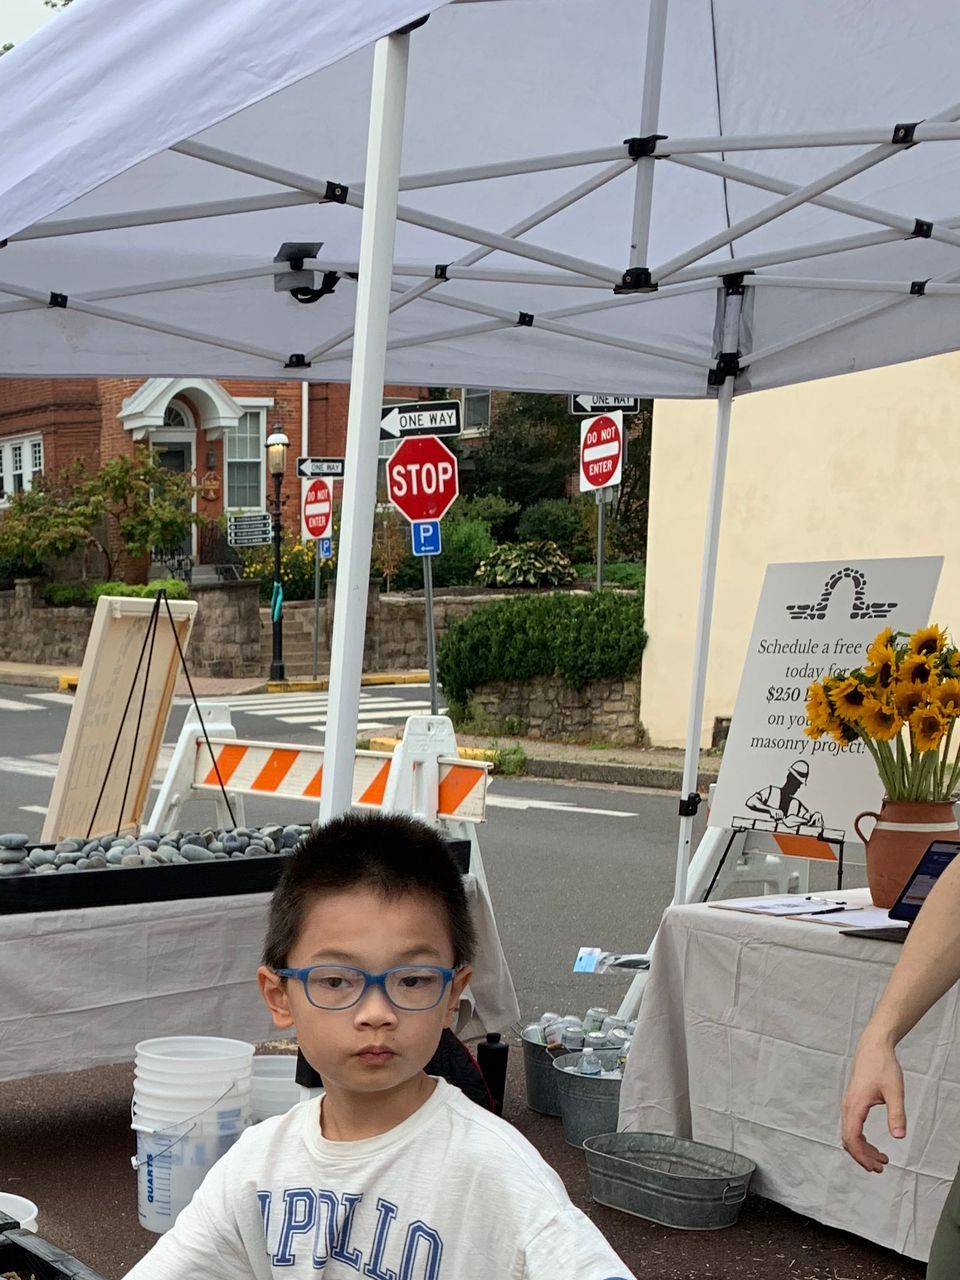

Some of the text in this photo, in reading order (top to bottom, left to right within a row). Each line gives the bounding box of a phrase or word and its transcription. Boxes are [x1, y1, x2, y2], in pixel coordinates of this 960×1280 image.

[592, 395, 631, 405] ONE WAY
[399, 411, 455, 428] ONE WAY
[586, 426, 616, 445] DO NOT
[311, 463, 339, 472] ONE WAY
[588, 459, 613, 476] ENTER
[391, 461, 453, 497] STOP
[307, 488, 328, 502] DO NOT
[308, 515, 326, 528] ENTER
[419, 524, 434, 544] P
[323, 540, 330, 553] P
[757, 638, 819, 655] Schedule
[821, 642, 830, 655] a
[833, 638, 862, 655] free
[785, 663, 825, 683] today
[766, 684, 801, 704] $250
[767, 713, 785, 726] on
[750, 736, 868, 757] masonry project!
[146, 1153, 155, 1204] QUARTS
